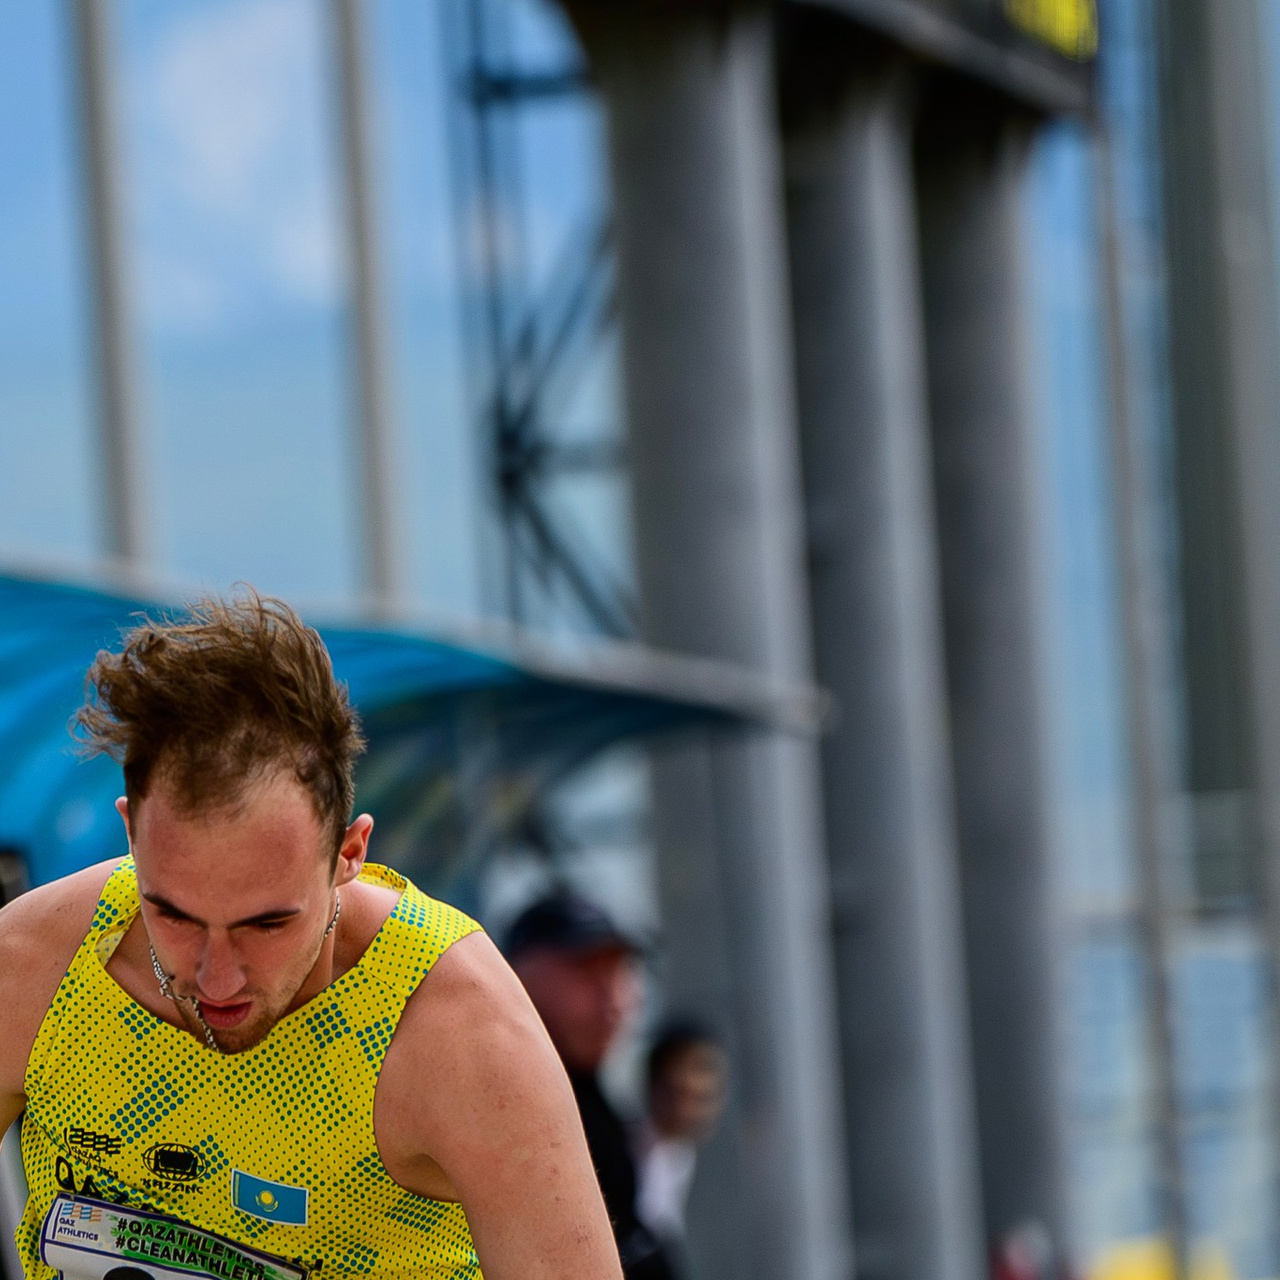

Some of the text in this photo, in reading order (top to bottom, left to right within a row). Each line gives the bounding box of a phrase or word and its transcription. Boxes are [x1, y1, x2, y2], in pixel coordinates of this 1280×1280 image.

[59, 1217, 76, 1227] QAZ
[57, 1226, 99, 1241] ATHLETICS
[117, 1218, 266, 1274] #QAZATHLETICS
